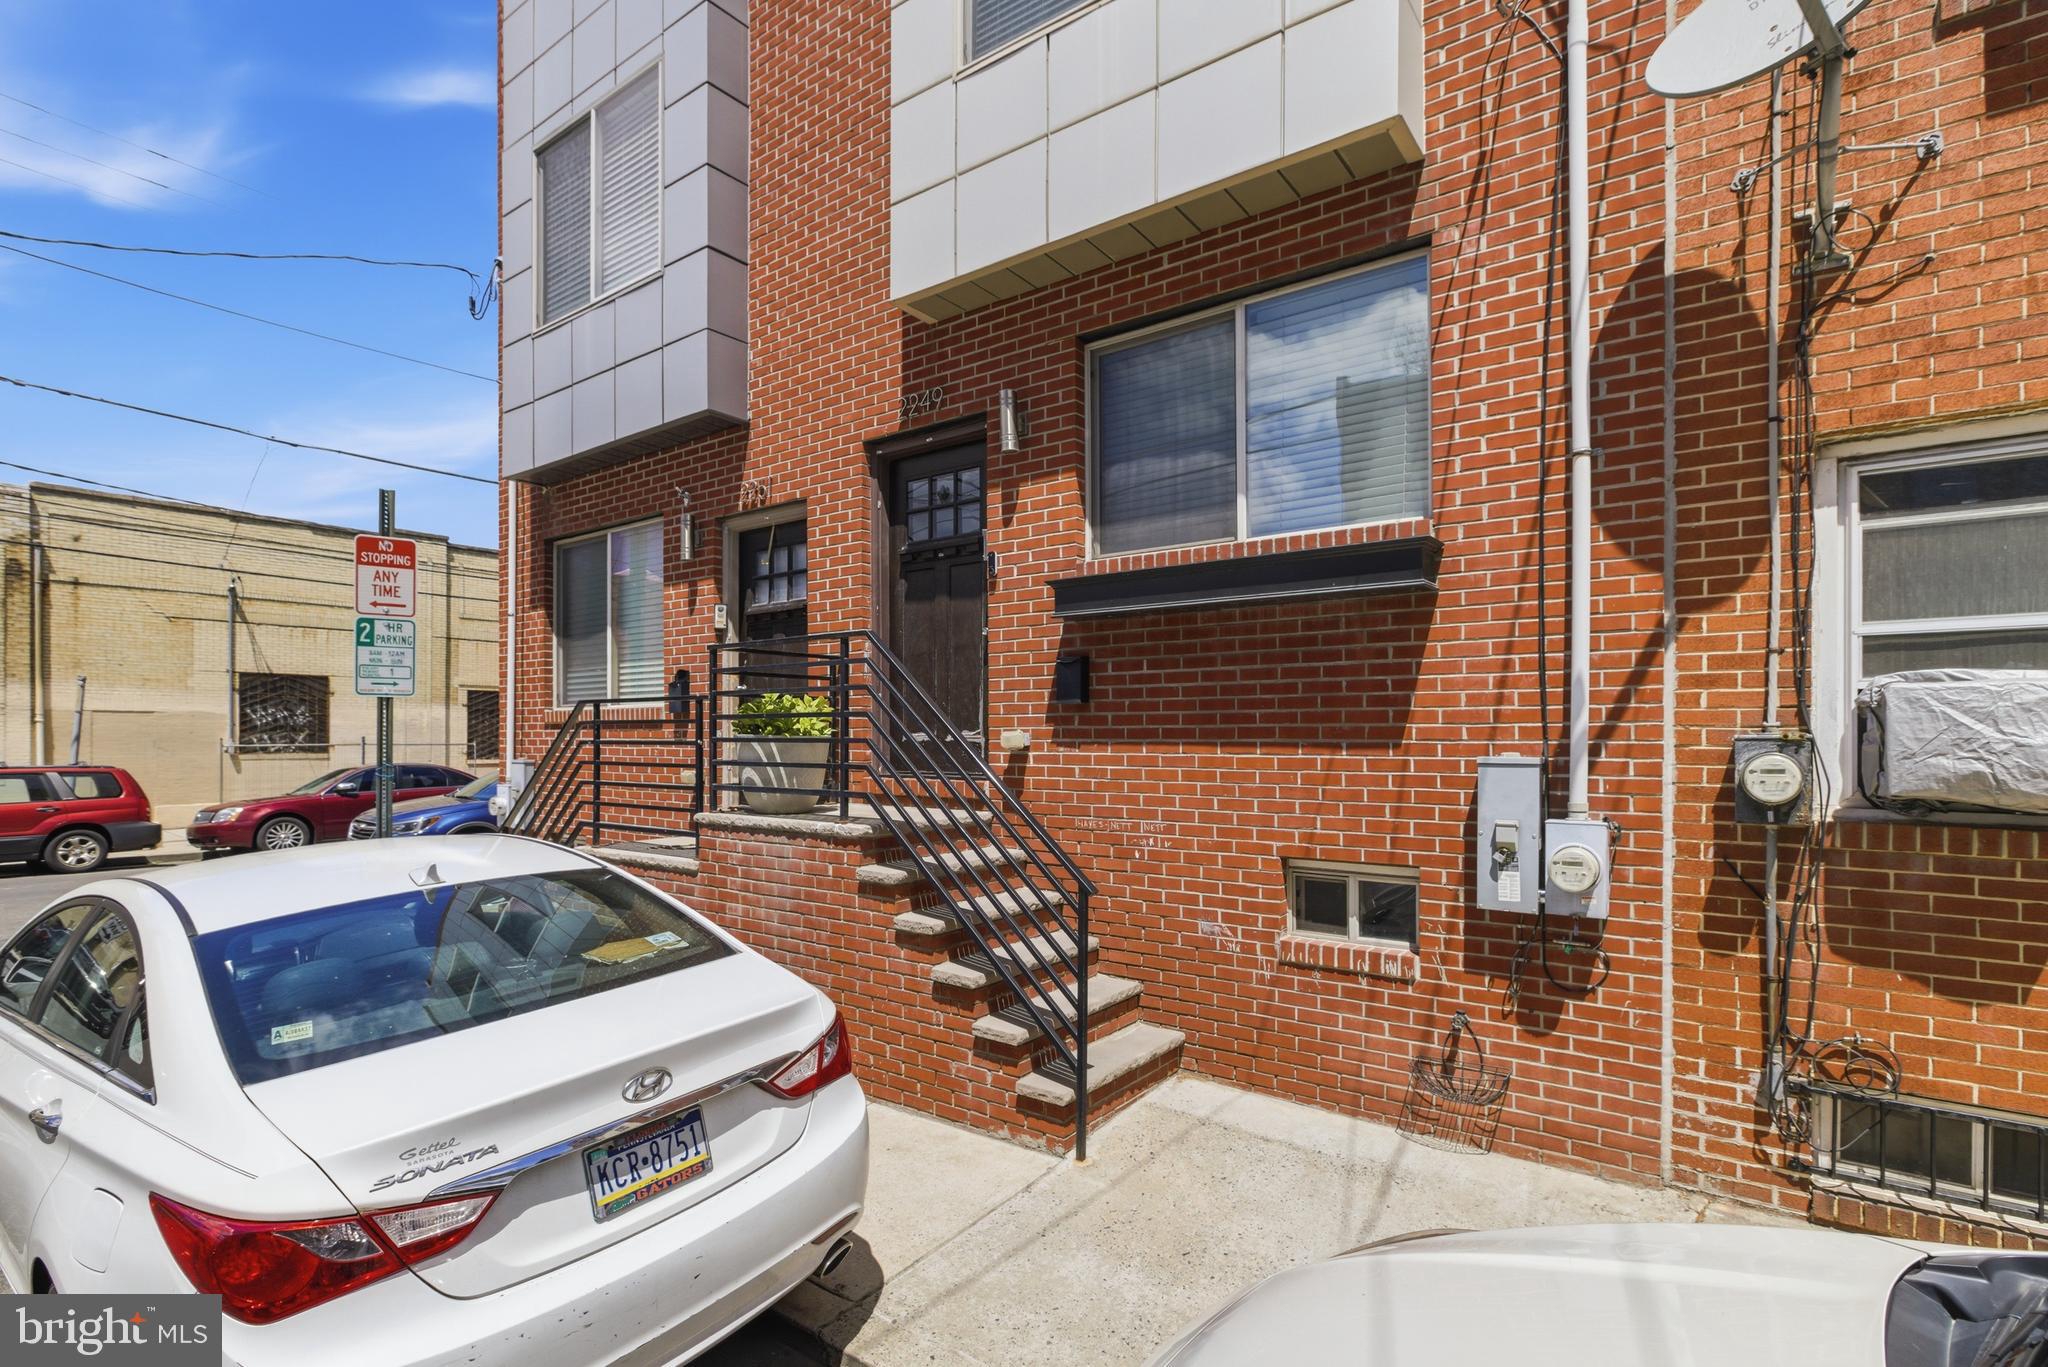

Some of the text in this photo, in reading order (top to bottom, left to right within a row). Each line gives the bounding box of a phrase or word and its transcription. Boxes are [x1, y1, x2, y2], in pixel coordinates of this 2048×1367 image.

[898, 387, 943, 421] 2249
[378, 540, 394, 552] NO
[360, 551, 411, 567] STOPPING
[373, 570, 399, 583] ANY
[371, 584, 401, 599] TIME
[359, 622, 403, 643] 2 HR
[375, 634, 413, 646] PARKING
[273, 1030, 282, 1040] A
[399, 1137, 461, 1161] Gettel
[369, 1134, 500, 1193] SONATA
[406, 1150, 455, 1167] SARASOTA
[635, 1162, 703, 1201] GATORS
